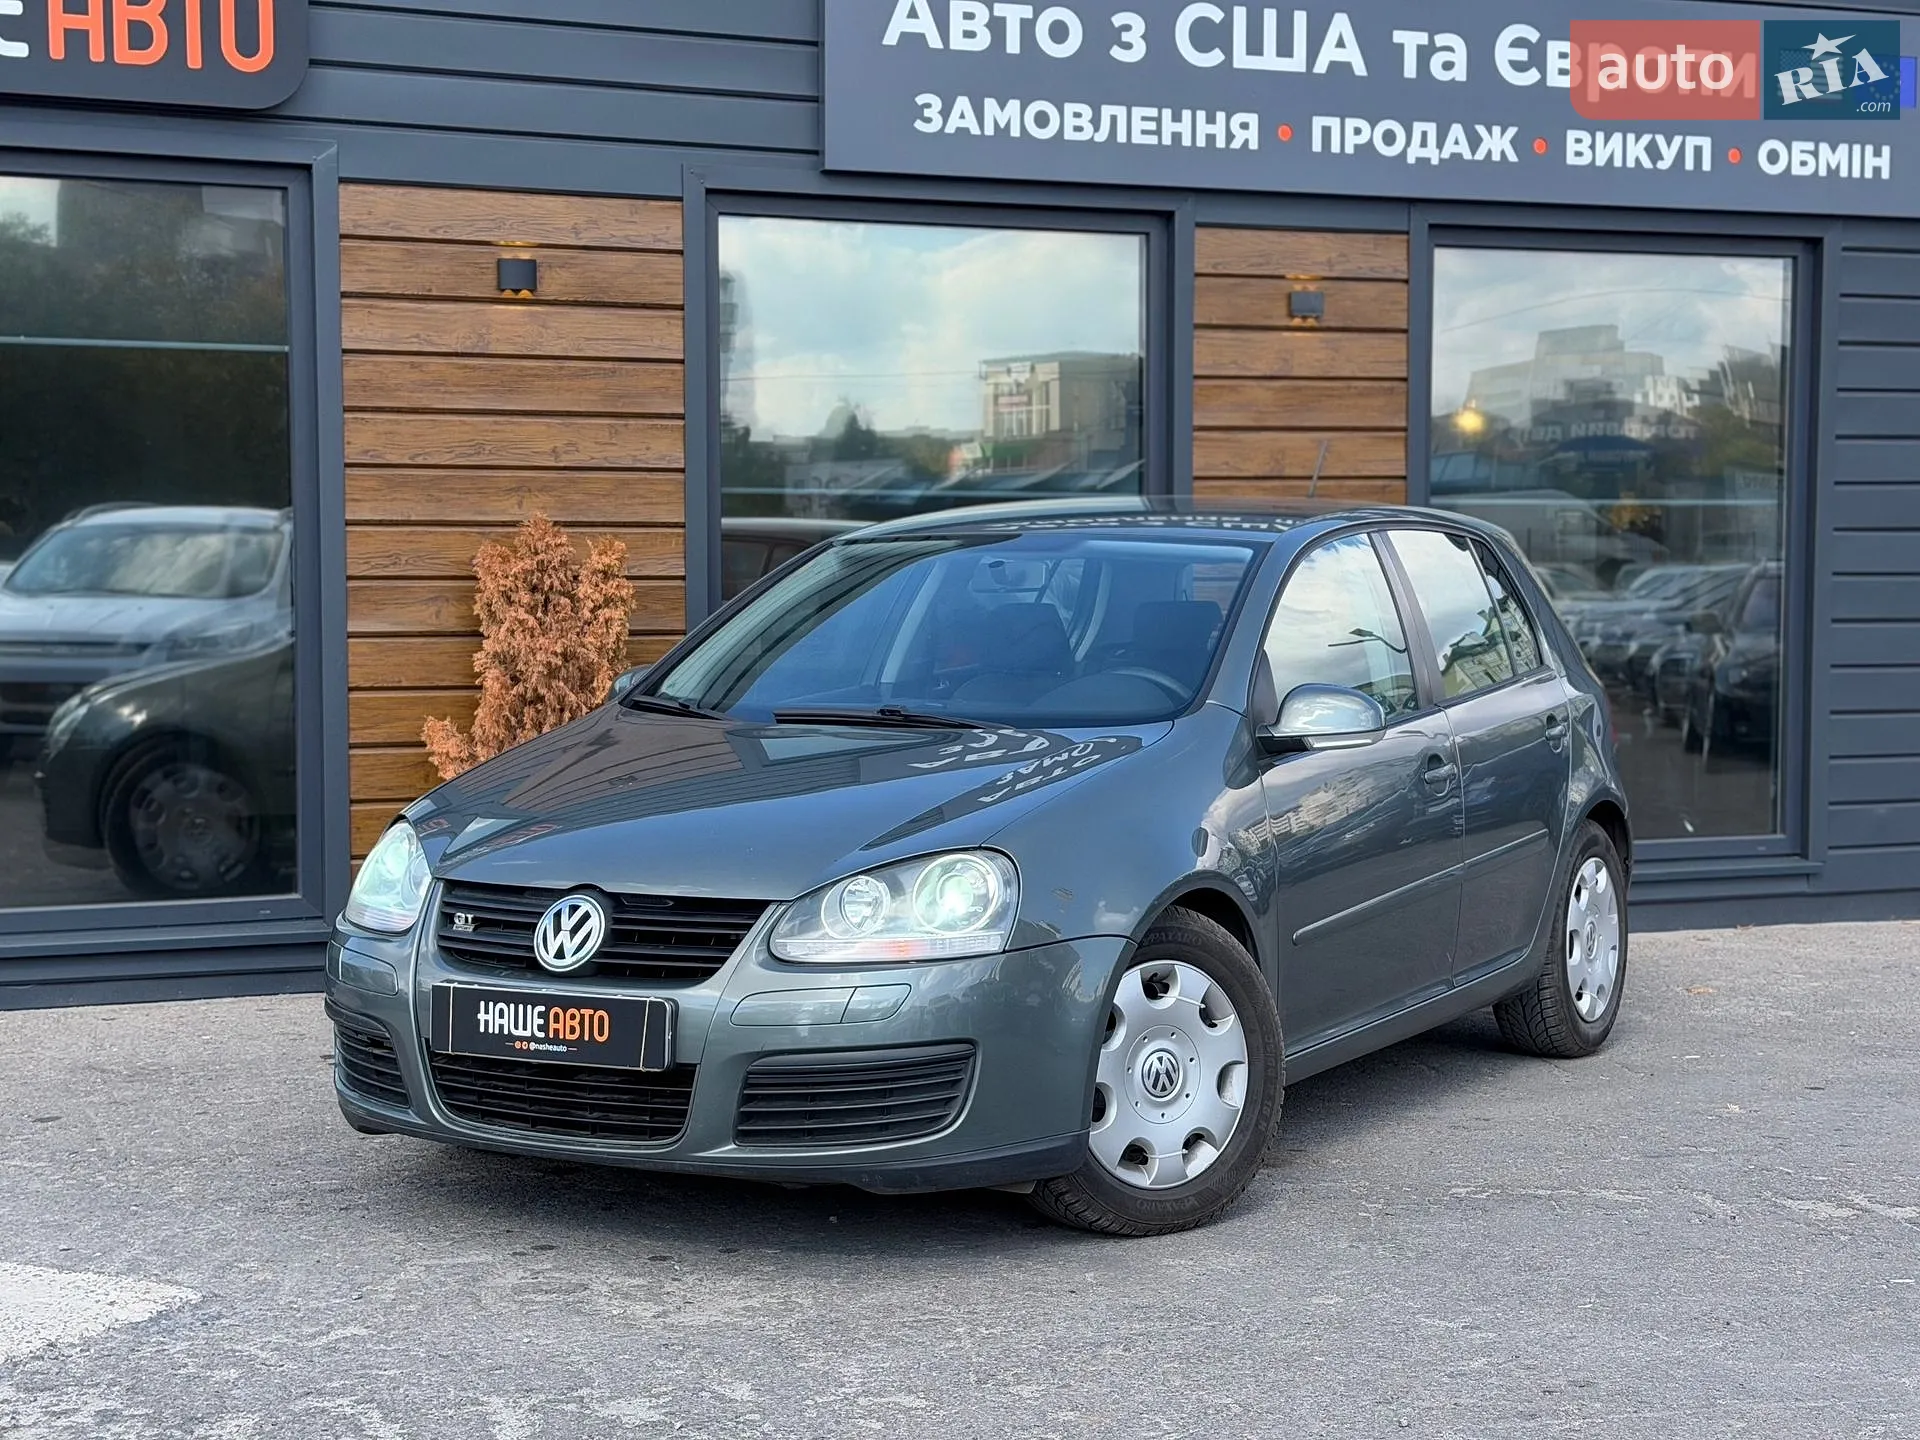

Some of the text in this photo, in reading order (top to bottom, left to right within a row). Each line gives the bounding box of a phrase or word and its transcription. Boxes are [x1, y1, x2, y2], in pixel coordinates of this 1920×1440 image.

[1174, 1, 1369, 77] США
[1392, 29, 1468, 82] та
[912, 92, 1892, 180] ЗАМОВЛЕННЯ ПРОДАЖ ВИКУП ОБМІН
[477, 1000, 610, 1042] НАШЕ АВТО
